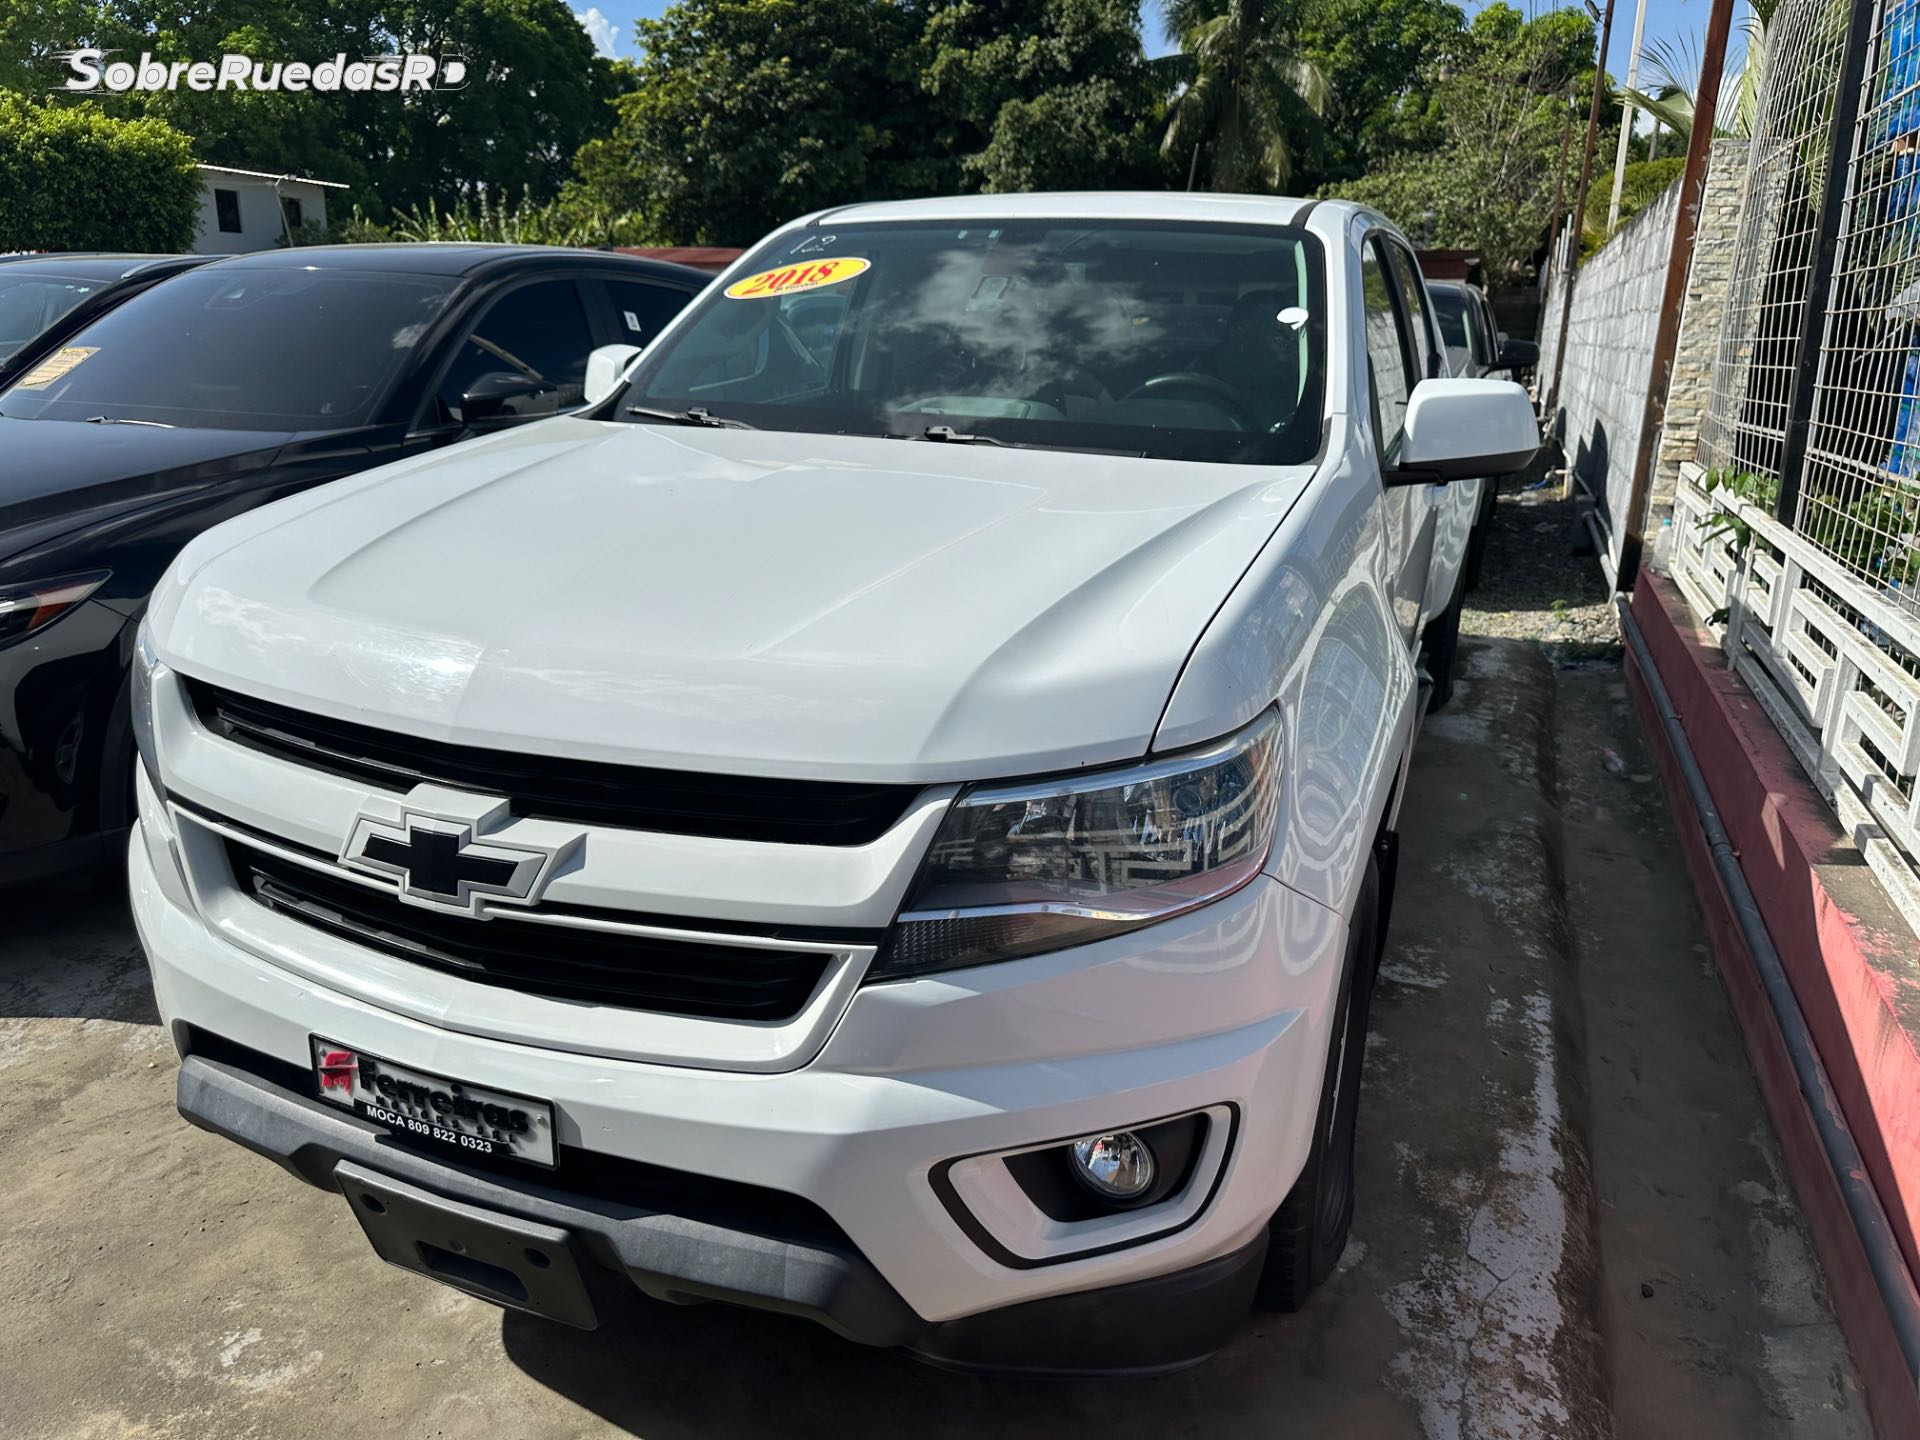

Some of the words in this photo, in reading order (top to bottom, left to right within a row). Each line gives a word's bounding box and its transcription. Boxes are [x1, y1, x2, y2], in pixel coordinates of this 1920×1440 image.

[742, 261, 839, 295] 2018
[357, 1057, 529, 1133] Ferreiras
[366, 1104, 405, 1128] MOCA
[407, 1118, 431, 1135] 809
[432, 1127, 457, 1144] 822
[460, 1135, 493, 1153] 0323
